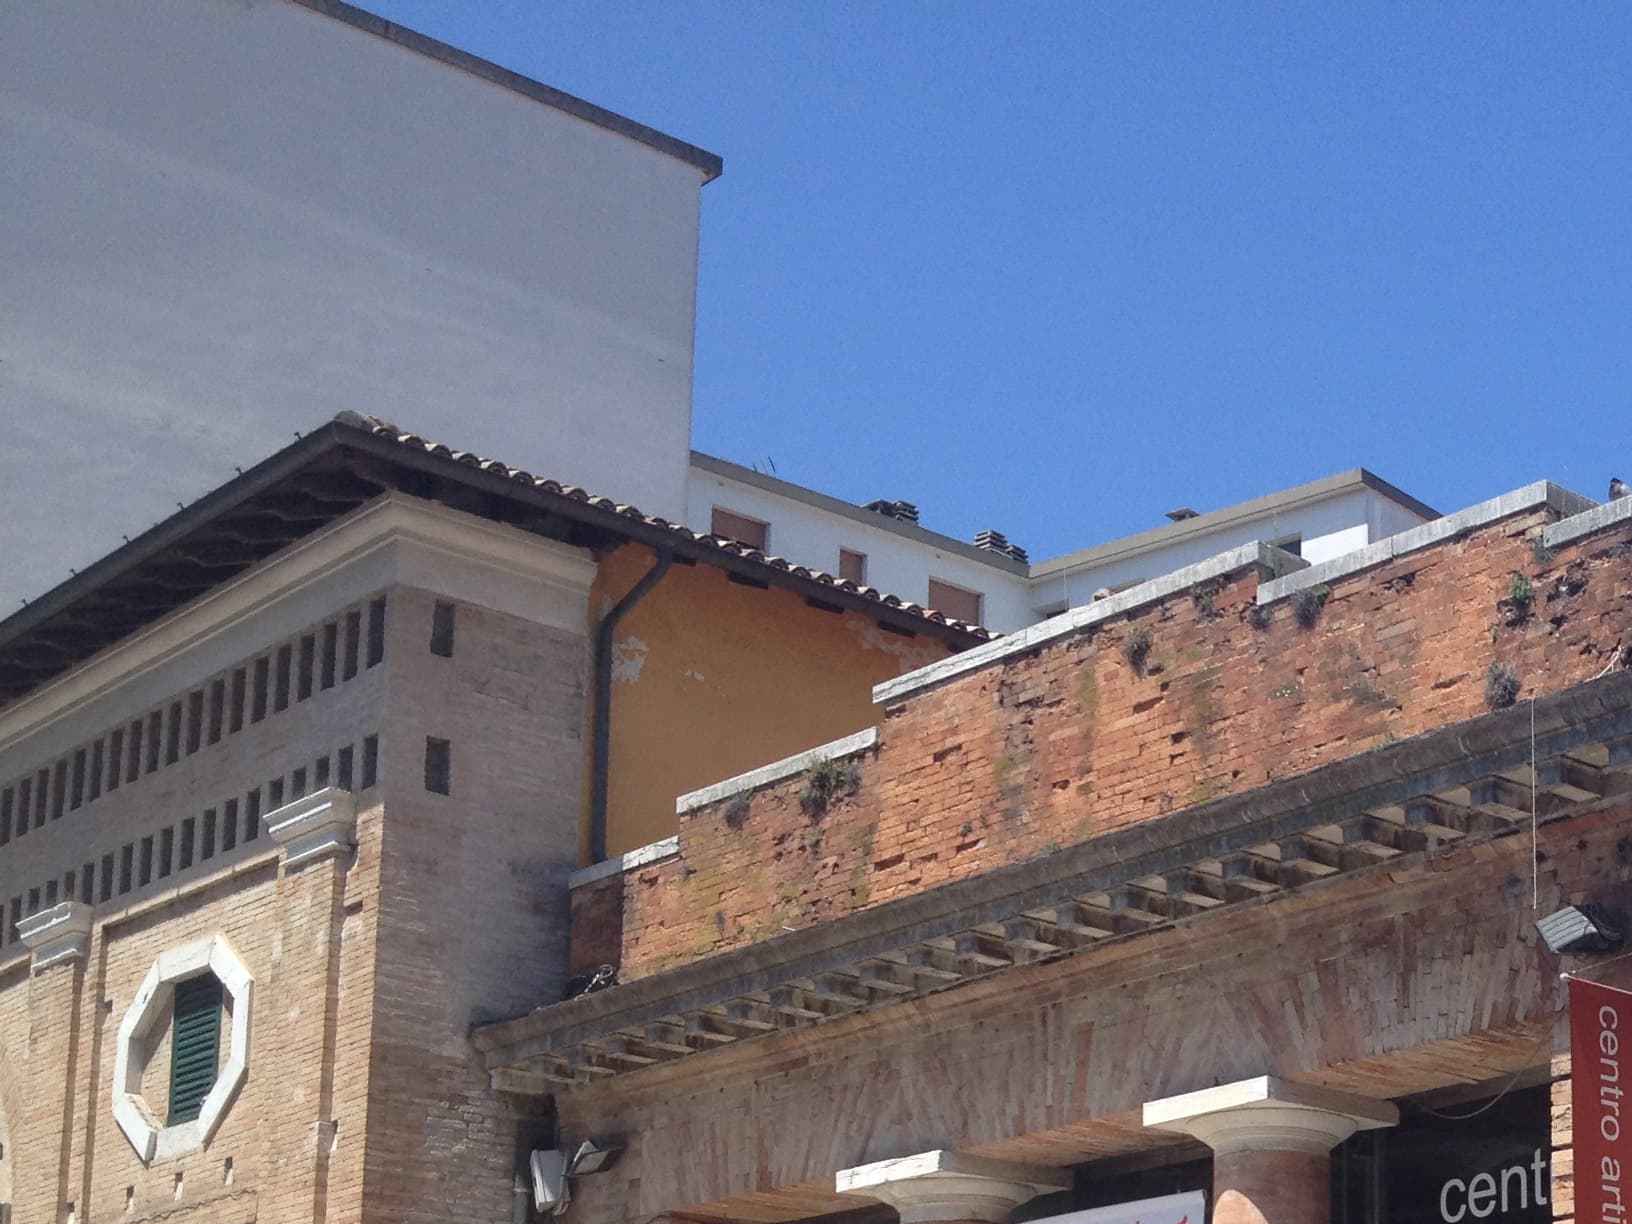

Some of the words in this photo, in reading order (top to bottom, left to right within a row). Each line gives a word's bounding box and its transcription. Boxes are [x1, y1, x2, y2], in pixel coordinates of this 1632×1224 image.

[1598, 1004, 1624, 1142] centro
[1439, 1147, 1548, 1224] cent
[1601, 1155, 1627, 1224] arti
